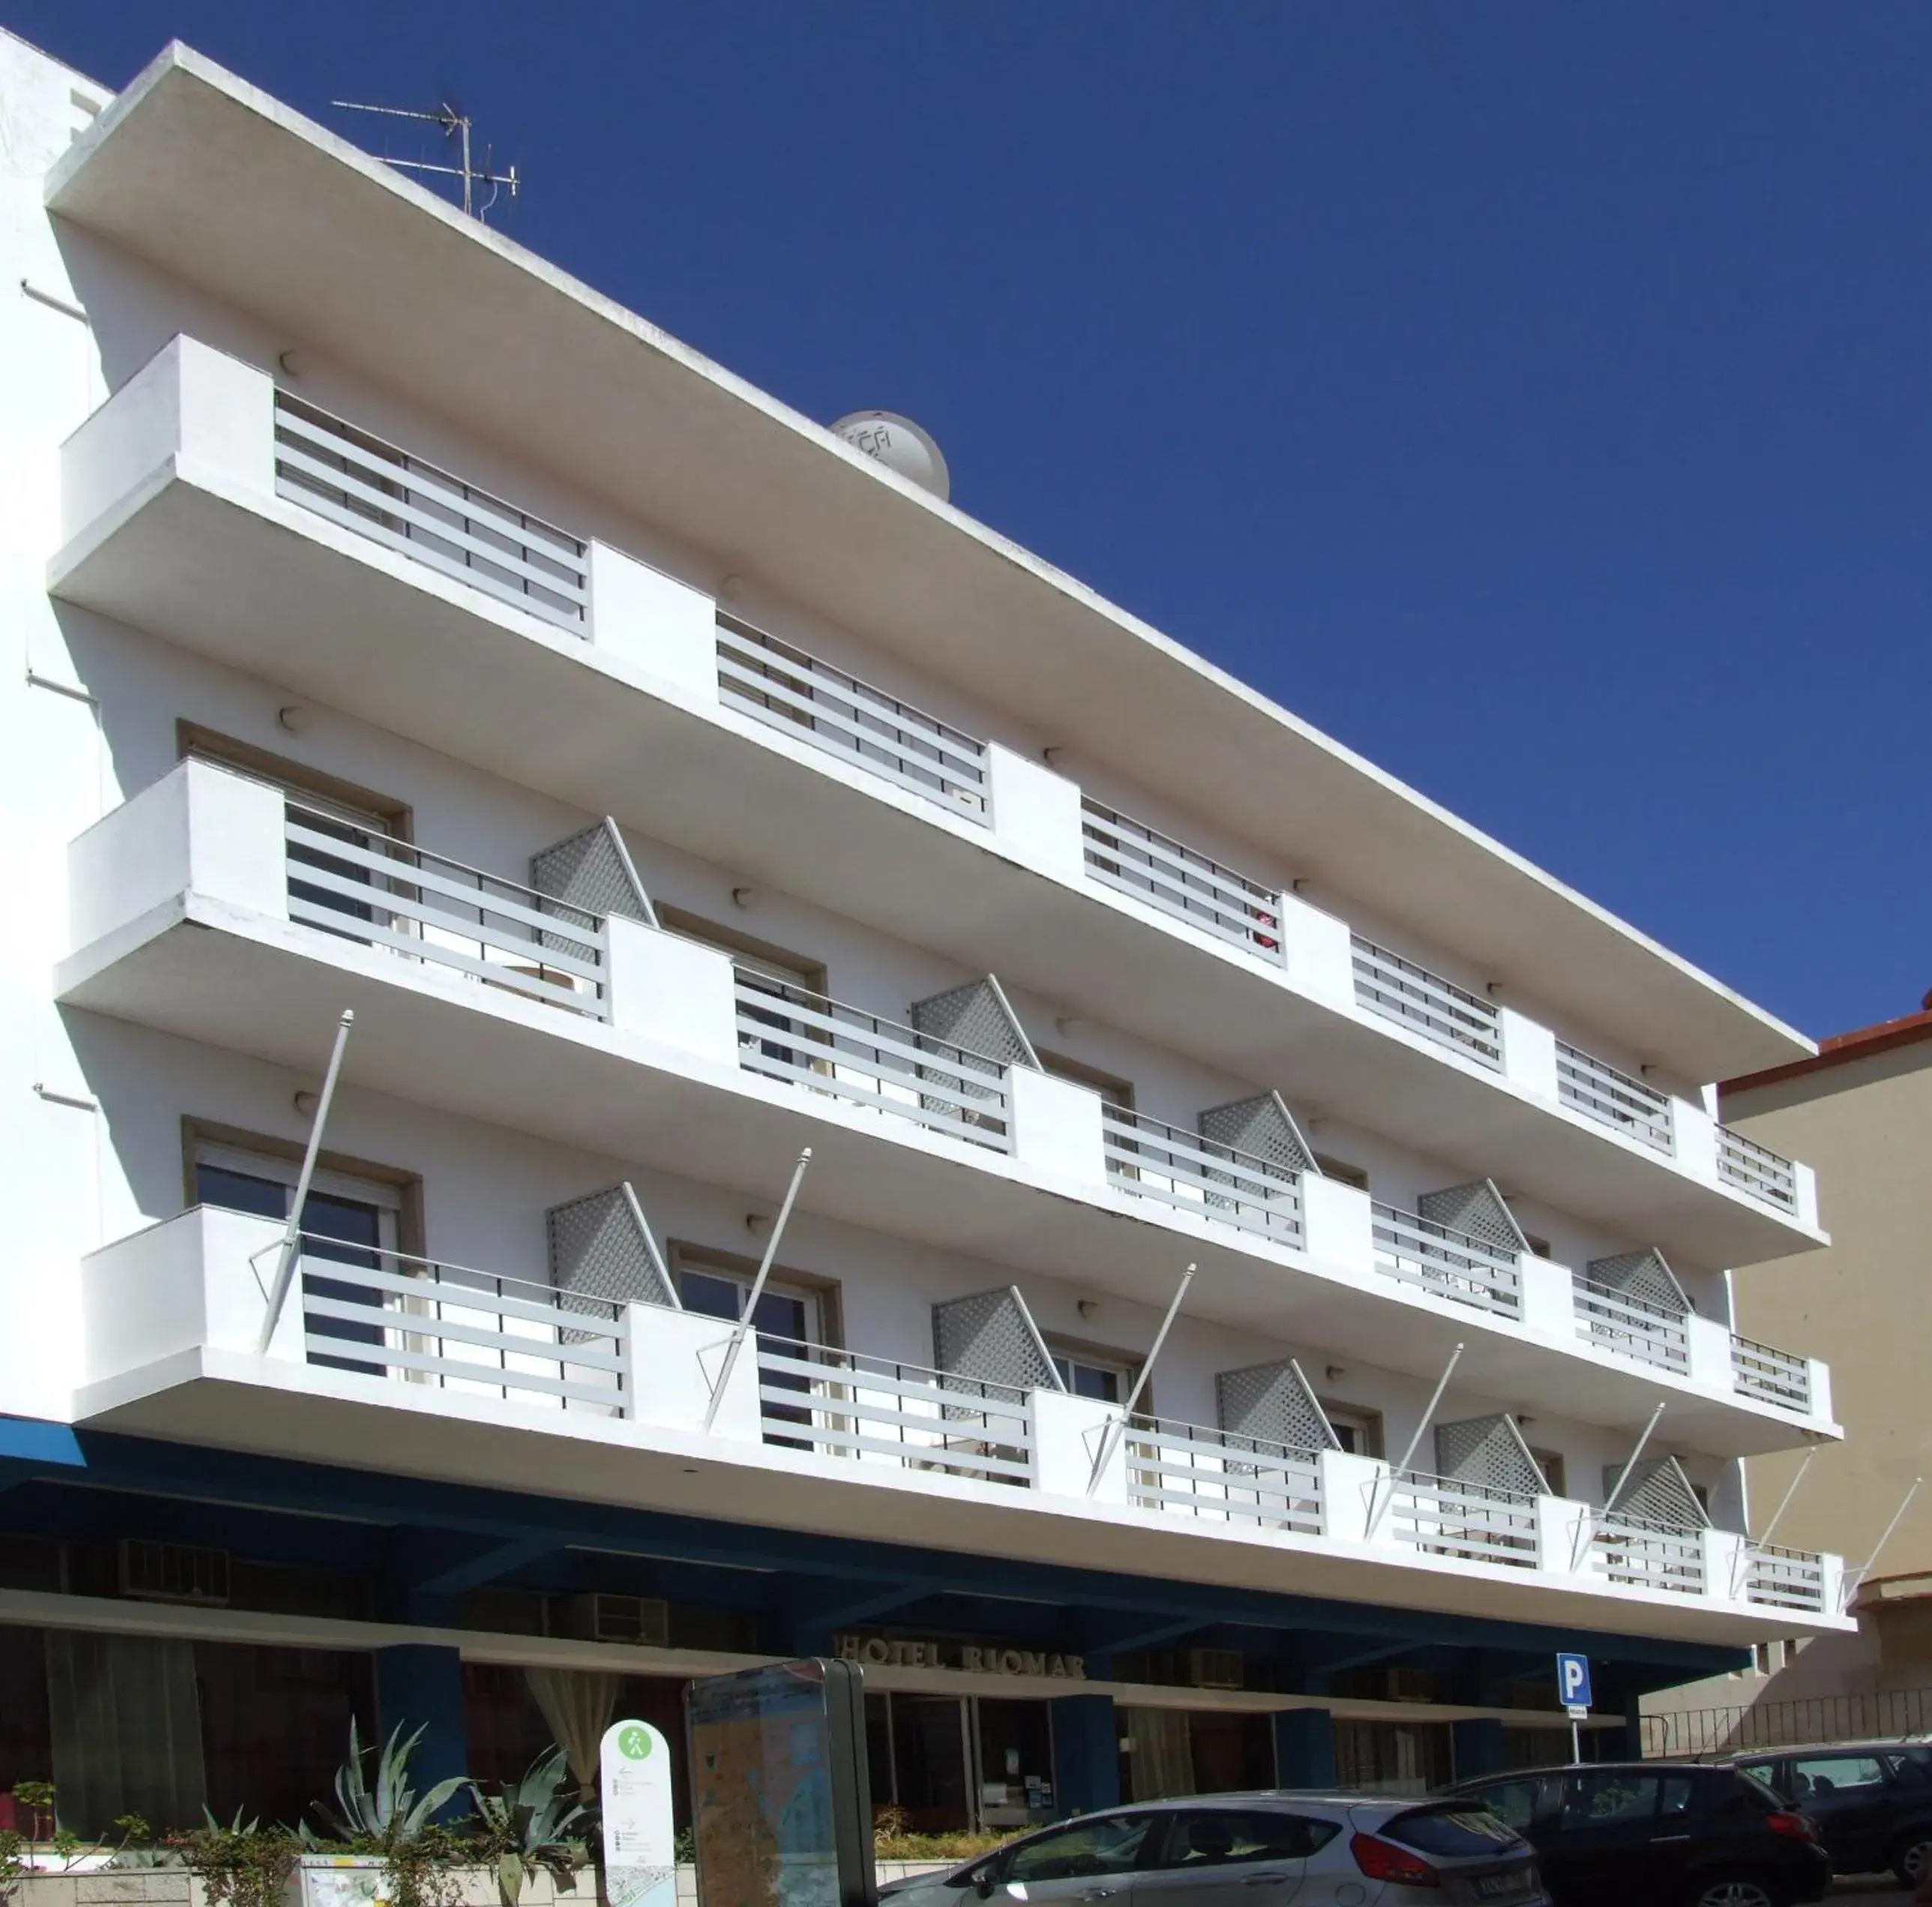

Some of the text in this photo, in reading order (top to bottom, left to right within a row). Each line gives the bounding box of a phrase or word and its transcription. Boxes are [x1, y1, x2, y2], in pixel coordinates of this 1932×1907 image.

[841, 1635, 1087, 1681] HOTEL RIOMAR
[1564, 1660, 1583, 1699] P
